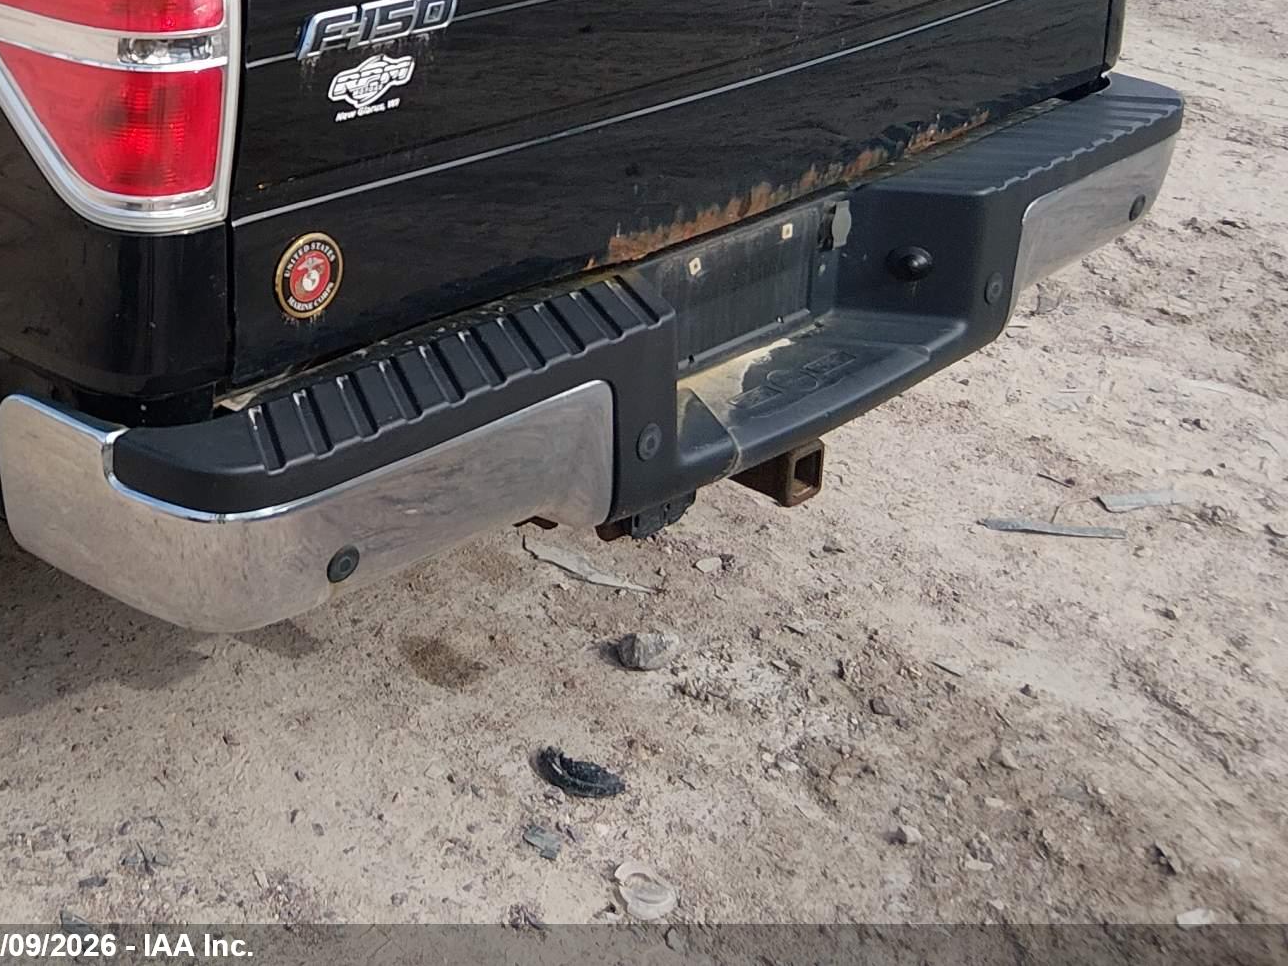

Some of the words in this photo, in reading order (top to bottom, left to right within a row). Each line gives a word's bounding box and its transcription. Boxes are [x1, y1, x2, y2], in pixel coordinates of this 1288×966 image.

[284, 244, 310, 278] UNITED
[311, 242, 336, 262] STATES
[287, 296, 314, 311] MARINE
[314, 282, 335, 307] CORPS
